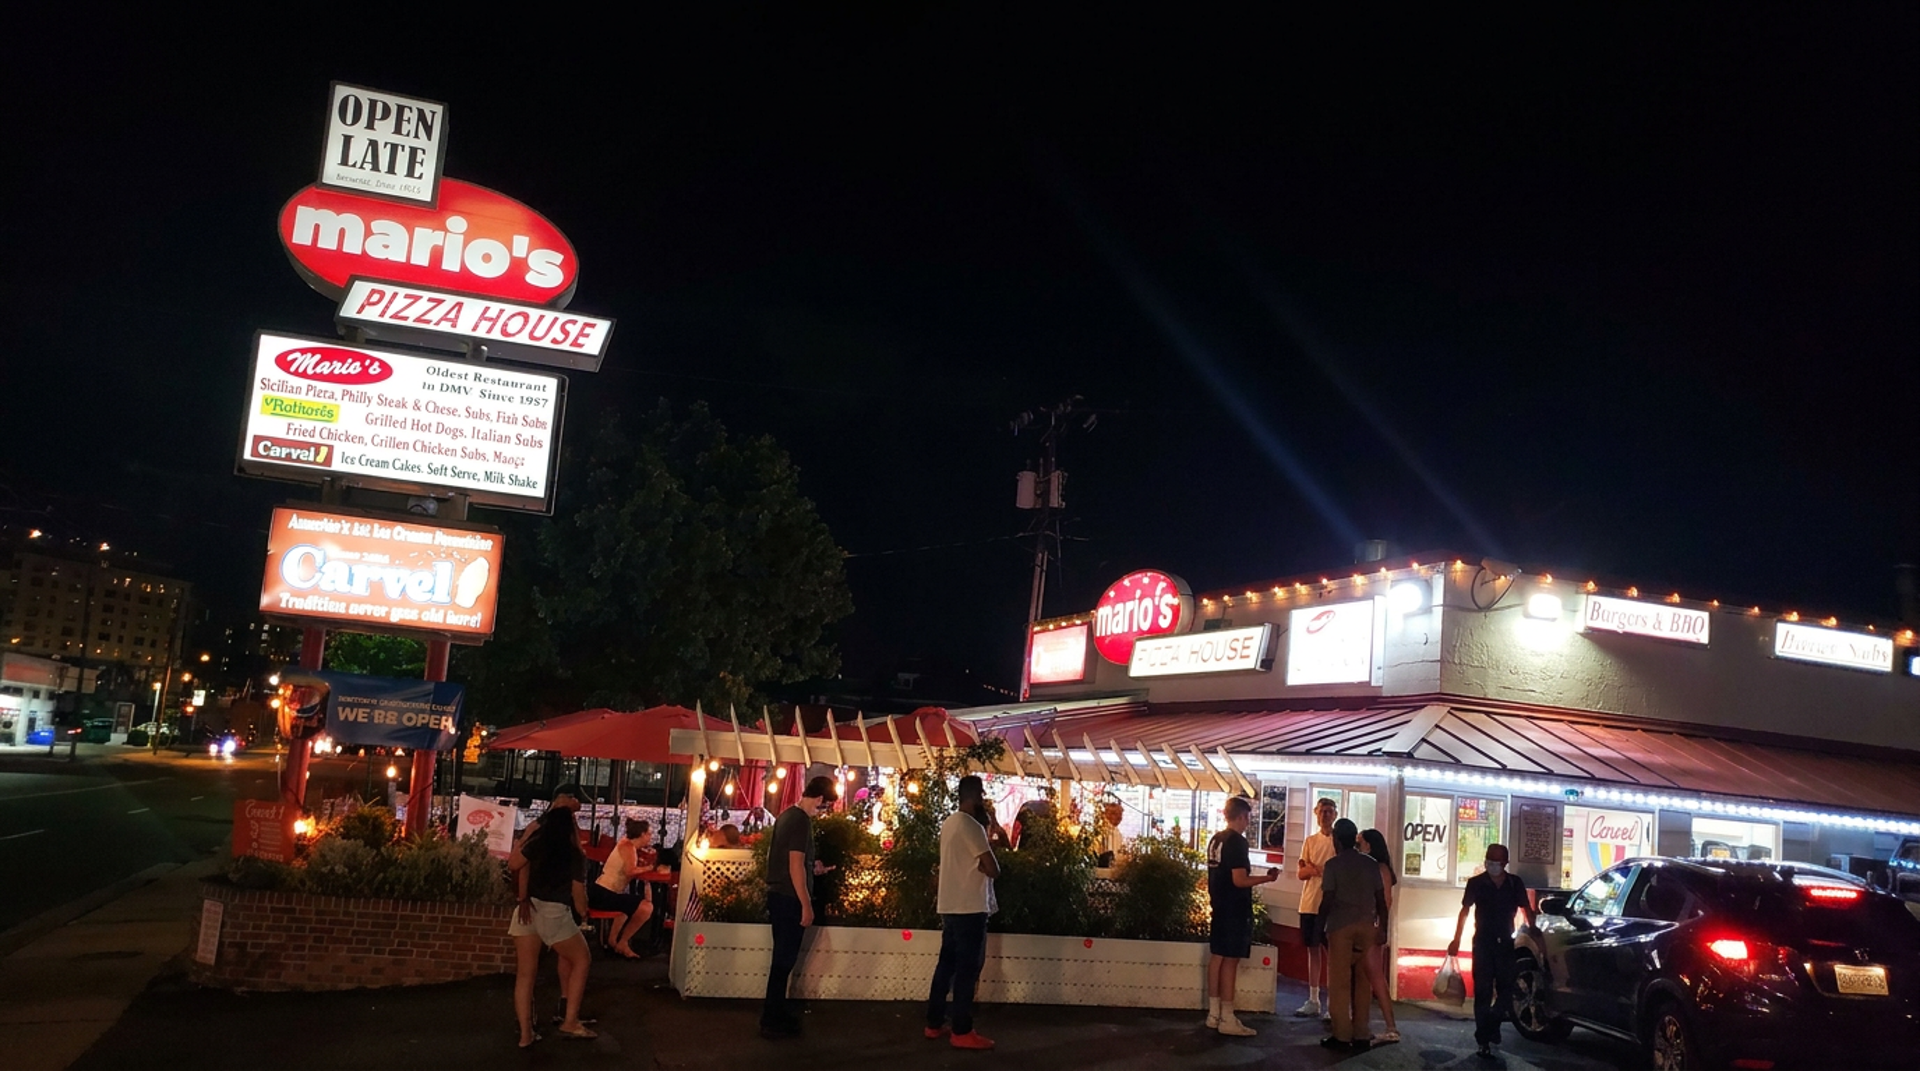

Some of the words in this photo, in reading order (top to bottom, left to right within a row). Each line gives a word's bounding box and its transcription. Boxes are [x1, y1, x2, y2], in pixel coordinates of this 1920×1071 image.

[338, 94, 438, 142] OPEN
[337, 134, 427, 181] LATE
[292, 206, 565, 288] mario's
[357, 288, 466, 329] PIZZA
[472, 306, 597, 349] HOUSE
[286, 352, 382, 375] Mario's
[426, 365, 469, 381] Oldest
[473, 372, 547, 393] Restaurant
[260, 377, 302, 396] Sicilian
[341, 389, 374, 408] Philly
[376, 393, 409, 410] Steak
[412, 399, 422, 412] &
[465, 406, 493, 423] Subs,
[286, 422, 316, 438] Fried
[319, 427, 368, 446] Chicken,
[412, 439, 457, 457] Chicken
[365, 412, 407, 430] Grilled
[411, 418, 432, 433] Hot
[471, 426, 511, 444] Italian
[515, 433, 544, 449] Subs
[258, 440, 316, 462] Carvel
[358, 454, 390, 469] Cream
[427, 463, 448, 478] Soft
[450, 466, 481, 482] Serve,
[483, 471, 505, 485] Milk
[508, 473, 538, 489] Shake
[281, 544, 455, 604] Carvel
[349, 601, 388, 617] never
[1096, 582, 1174, 637] mario's
[1590, 600, 1648, 630] Burgers
[1653, 612, 1664, 632] &
[1188, 636, 1254, 663] HOUSE
[1404, 822, 1447, 843] OPEN
[1590, 815, 1639, 841] Carvel
